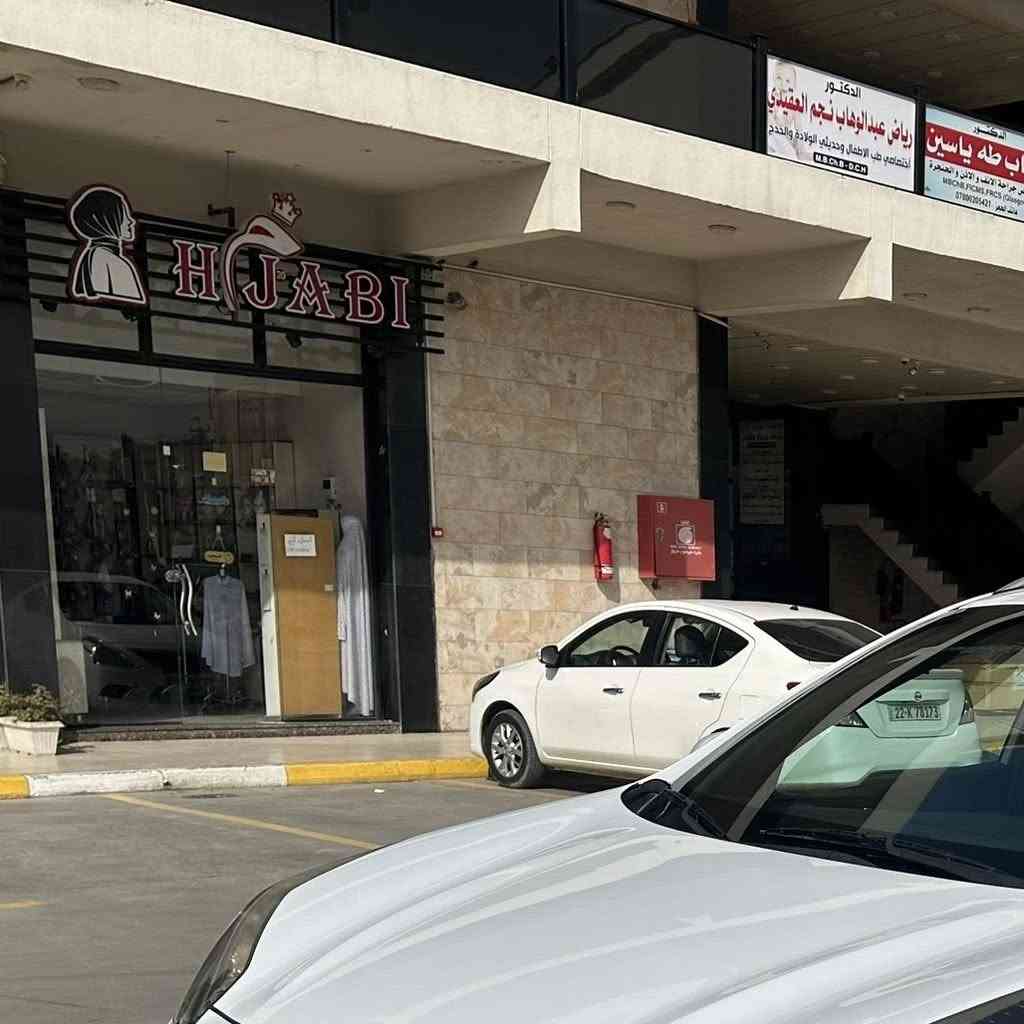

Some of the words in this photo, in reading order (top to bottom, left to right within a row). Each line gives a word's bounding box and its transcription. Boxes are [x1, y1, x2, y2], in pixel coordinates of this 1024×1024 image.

[824, 81, 860, 97] الدكتور
[767, 87, 807, 115] العقيدي
[810, 99, 833, 124] نجم
[794, 129, 817, 143] الولادة
[887, 119, 912, 148] رياض
[973, 126, 1006, 139] الدكتور
[870, 152, 881, 161] طب
[926, 128, 972, 164] ياسين
[977, 144, 1001, 165] طه
